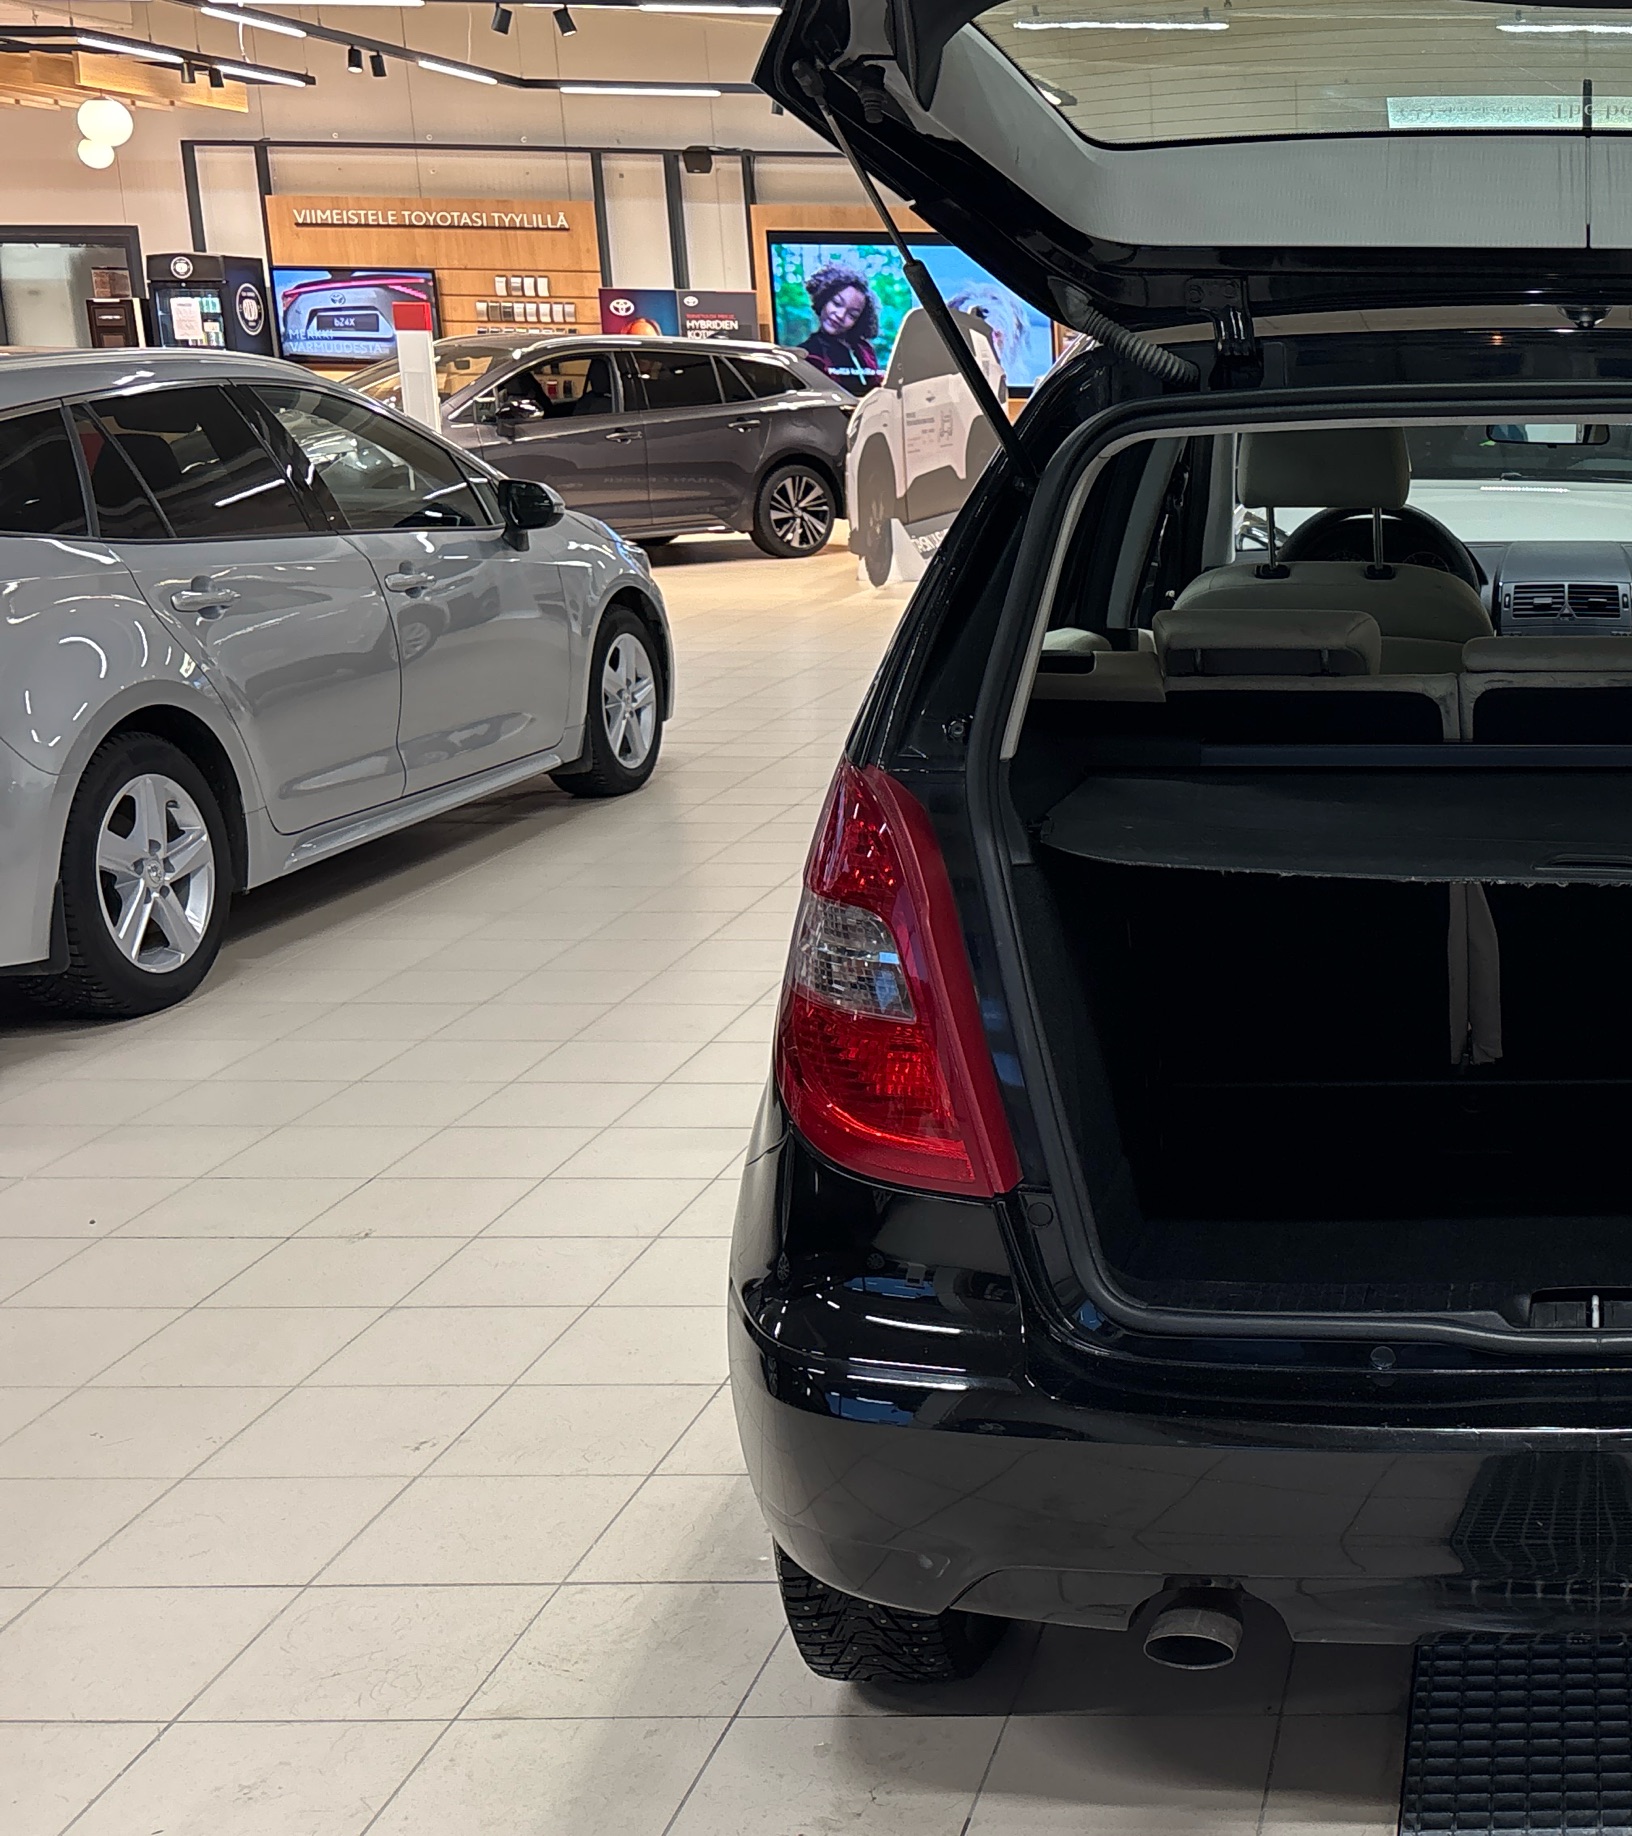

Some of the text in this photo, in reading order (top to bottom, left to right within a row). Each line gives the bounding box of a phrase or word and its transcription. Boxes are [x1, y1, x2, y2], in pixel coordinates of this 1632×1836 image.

[292, 208, 570, 229] VIIMEISTELE TOYOTASI TYYLILLÄ
[333, 317, 356, 327] bZ4X
[686, 319, 738, 330] HYBRIDIEN
